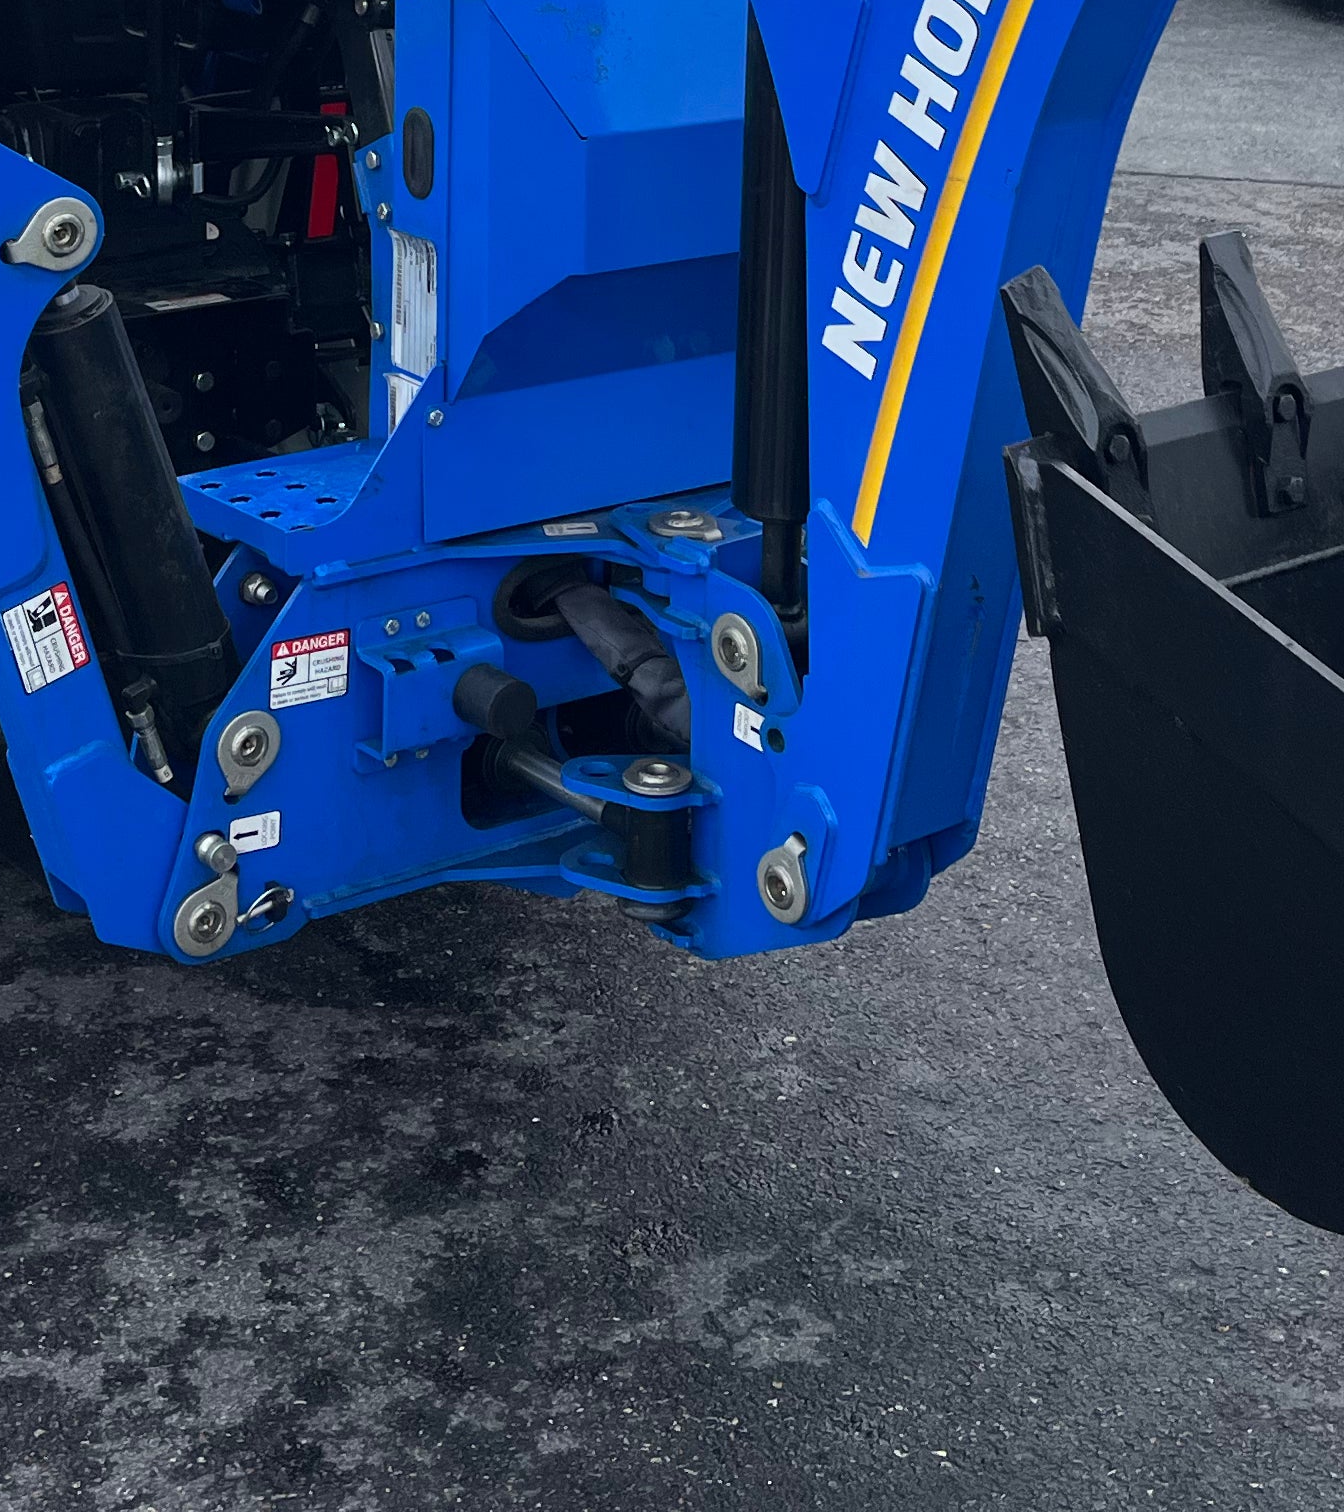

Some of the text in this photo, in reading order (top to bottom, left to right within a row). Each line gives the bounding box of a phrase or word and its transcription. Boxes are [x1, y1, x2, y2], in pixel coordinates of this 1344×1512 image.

[822, 139, 927, 380] NEW
[59, 605, 87, 664] DANGER
[292, 633, 345, 653] DANGER
[43, 645, 56, 674] HAZARD
[50, 637, 66, 673] CRUSHING
[313, 655, 345, 666] CRUSHING
[315, 665, 341, 675] HAZARD
